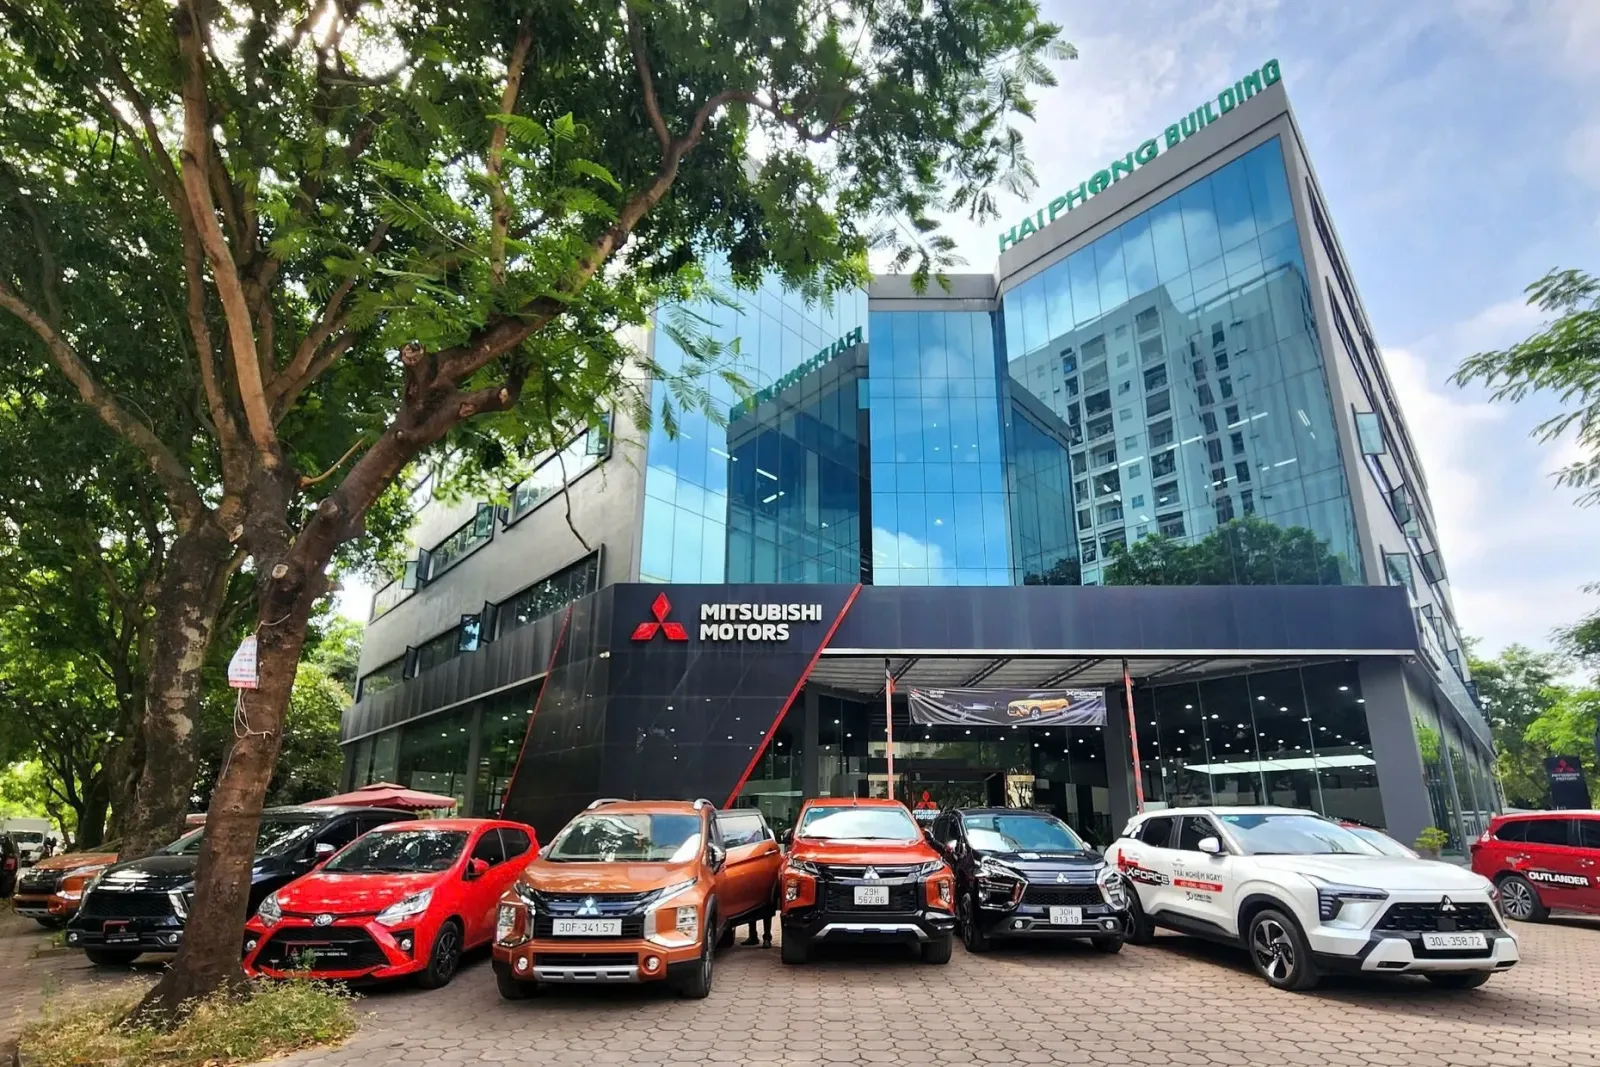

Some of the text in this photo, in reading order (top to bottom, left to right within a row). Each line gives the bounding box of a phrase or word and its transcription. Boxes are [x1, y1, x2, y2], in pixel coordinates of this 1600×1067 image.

[1163, 57, 1282, 149] BUILDING
[700, 603, 822, 622] MITSUBISHI
[700, 623, 790, 641] MOTORS
[1126, 866, 1171, 886] XFORCE
[1528, 871, 1589, 886] OUTLANDER
